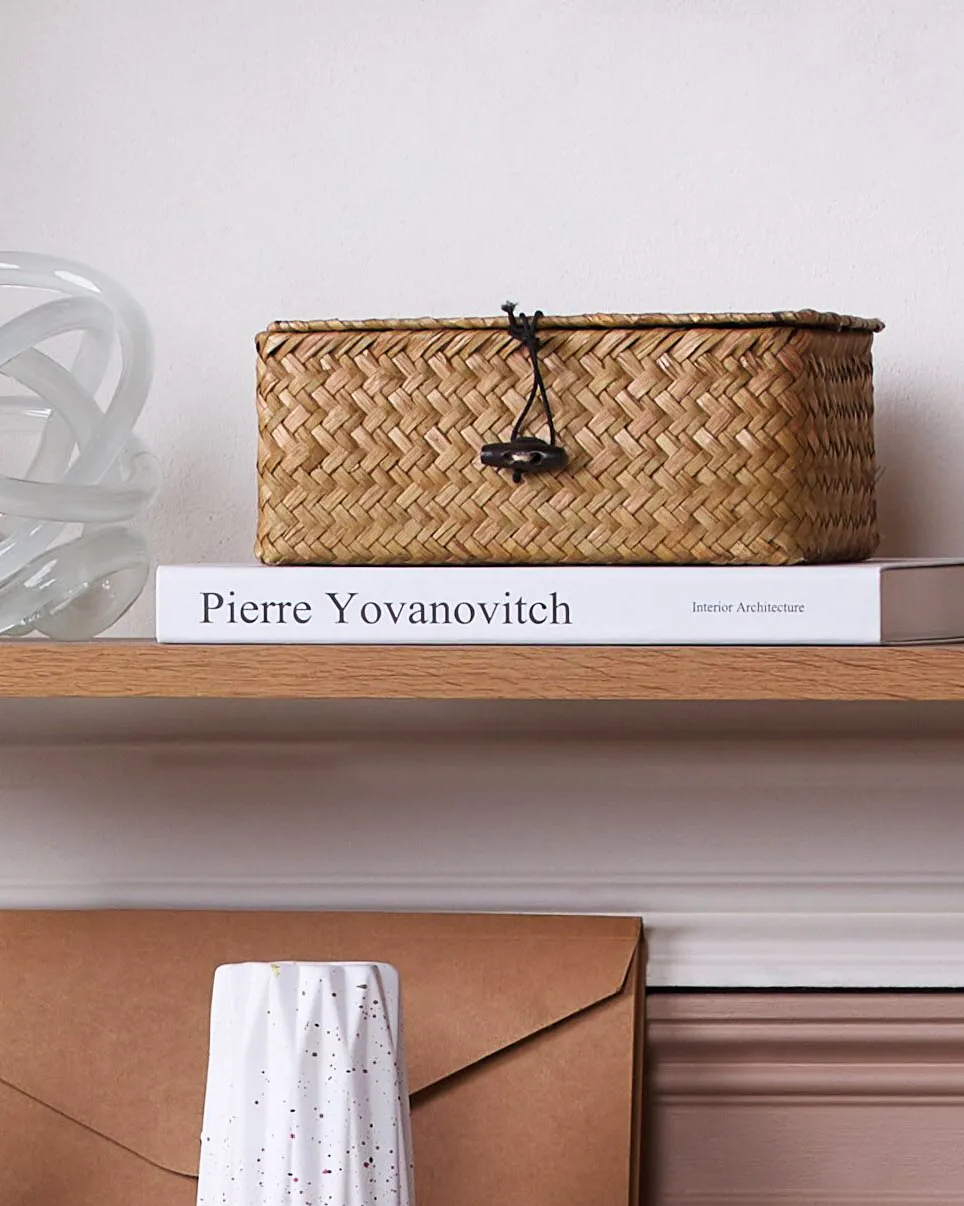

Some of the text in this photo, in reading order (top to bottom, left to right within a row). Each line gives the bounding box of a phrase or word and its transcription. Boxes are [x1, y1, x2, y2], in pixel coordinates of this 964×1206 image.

[200, 589, 573, 625] Pierre Yovanovitch
[692, 601, 805, 613] Interior Architecture
